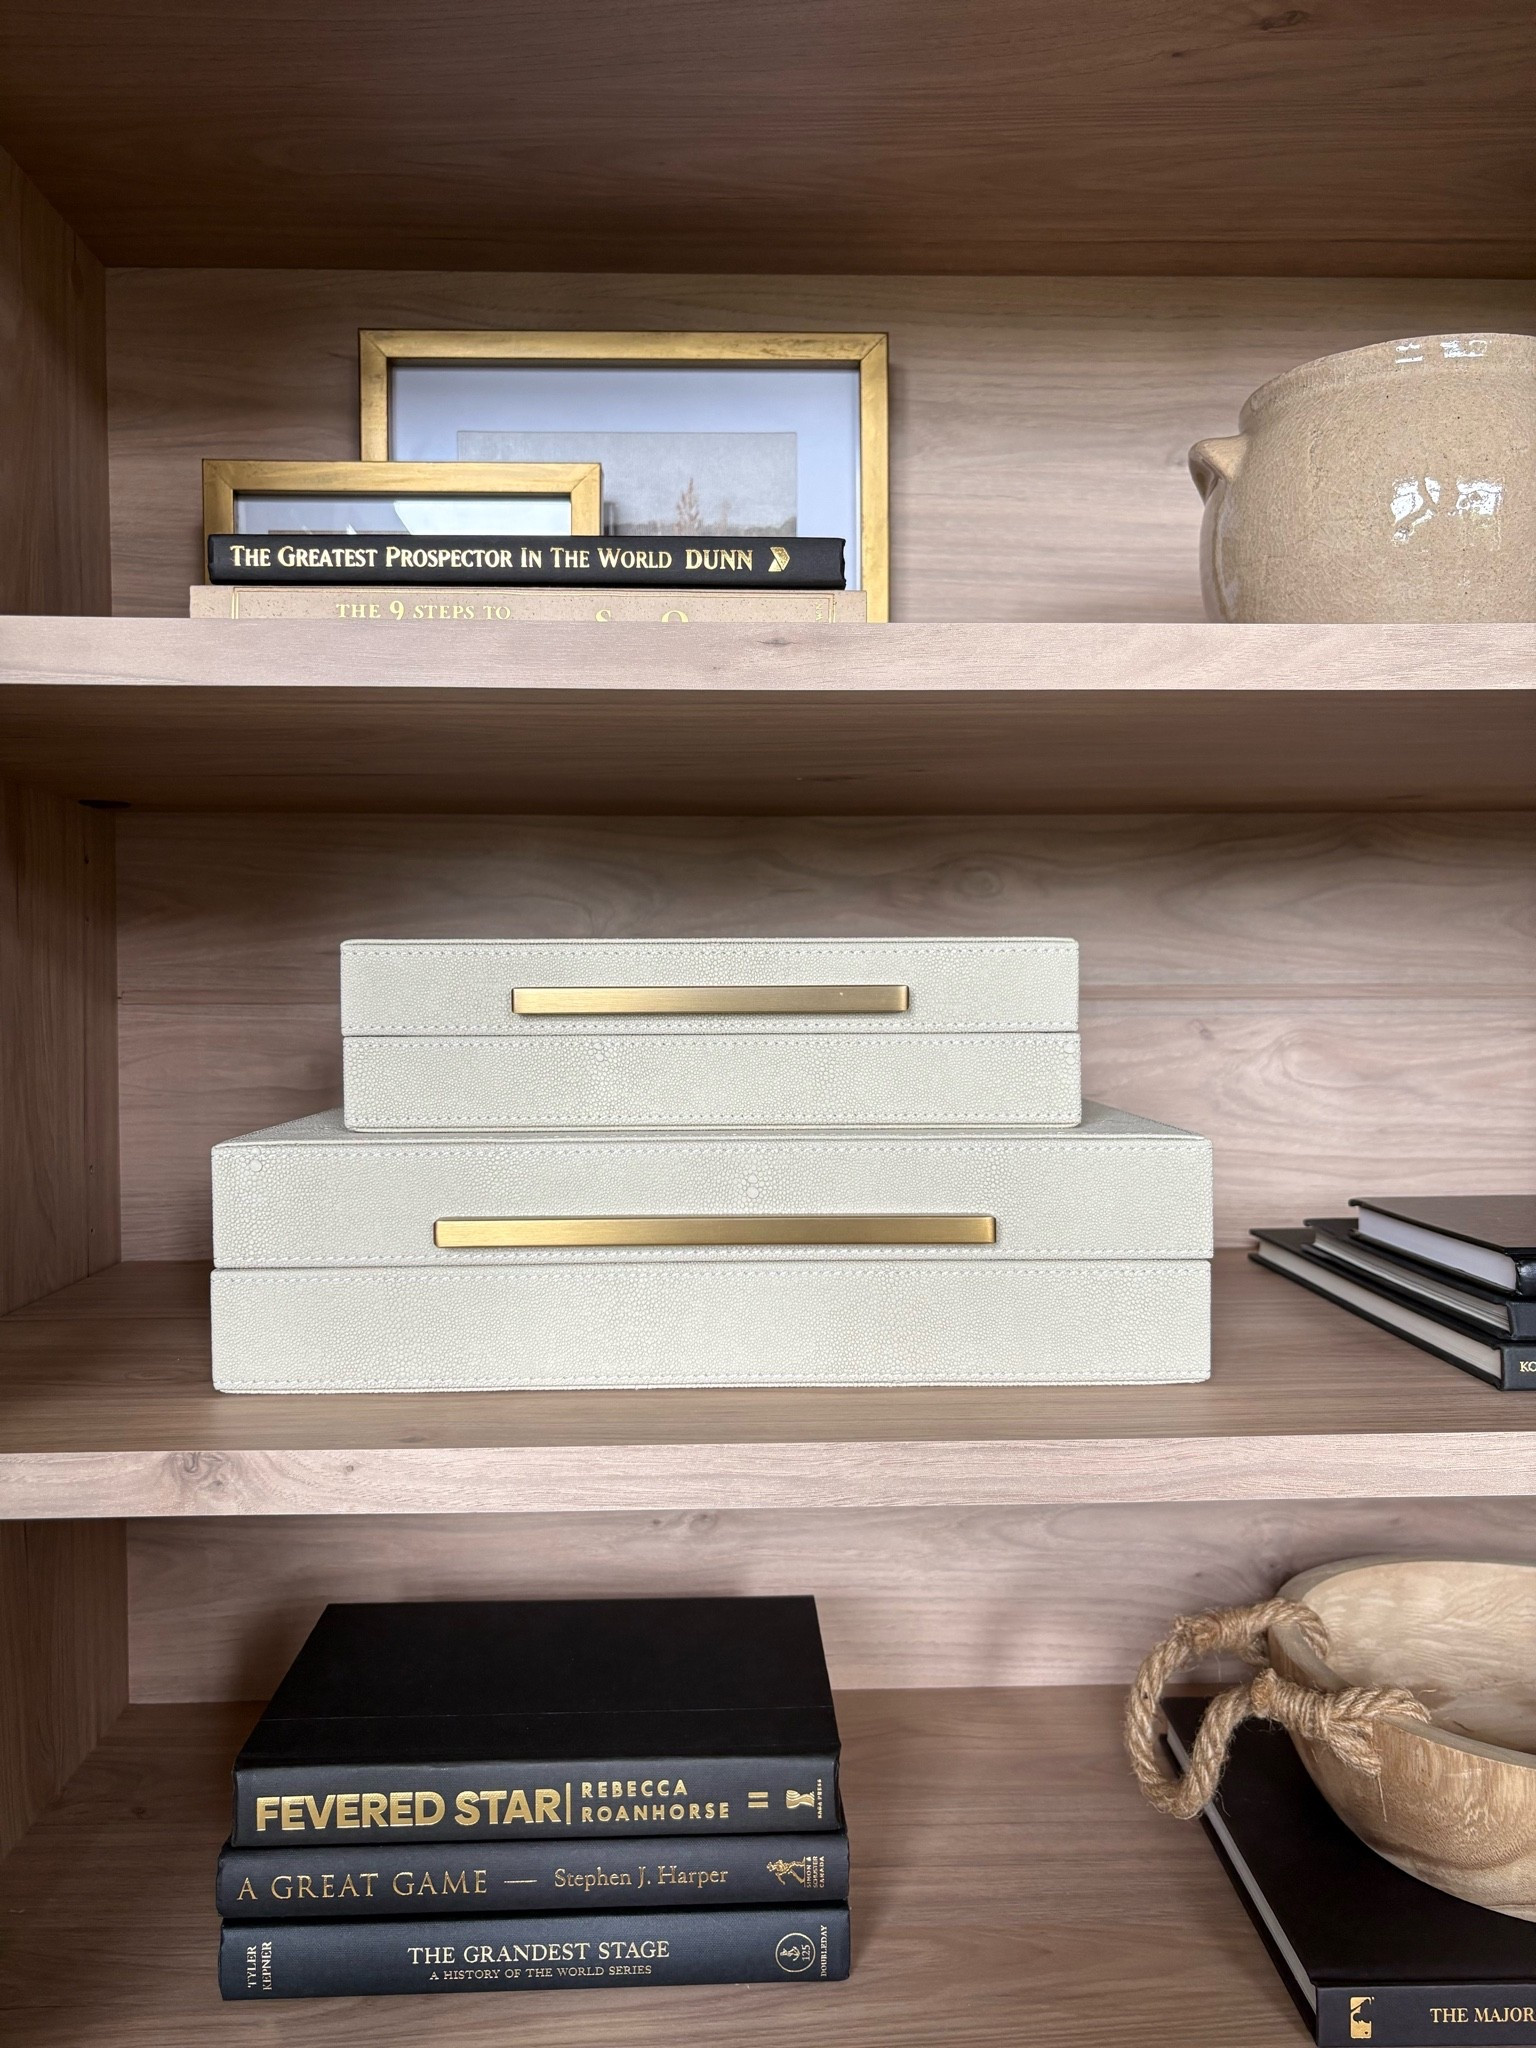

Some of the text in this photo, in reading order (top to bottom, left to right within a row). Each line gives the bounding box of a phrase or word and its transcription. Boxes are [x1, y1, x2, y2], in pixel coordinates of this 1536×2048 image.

[230, 545, 672, 569] THE GREATEST PROSPECTOR IN THE WORLD
[685, 548, 753, 571] DUNN
[336, 601, 511, 620] THE 9 STEPS TO
[581, 1780, 688, 1798] REBECCA
[256, 1789, 563, 1832] FEVERED STAR
[582, 1802, 730, 1822] ROANHORSE
[237, 1870, 488, 1900] A GREAT GAME
[554, 1867, 729, 1890] Stephen J. Harper
[408, 1942, 670, 1963] THE GRANDEST STAGE
[802, 1945, 811, 1961] 125
[247, 1946, 257, 1988] TYLER
[261, 1942, 272, 1990] KEPNER
[430, 1965, 652, 1980] A HISTORY OF THE WORLD SERIES
[1430, 2008, 1536, 2022] THE MAJOR
